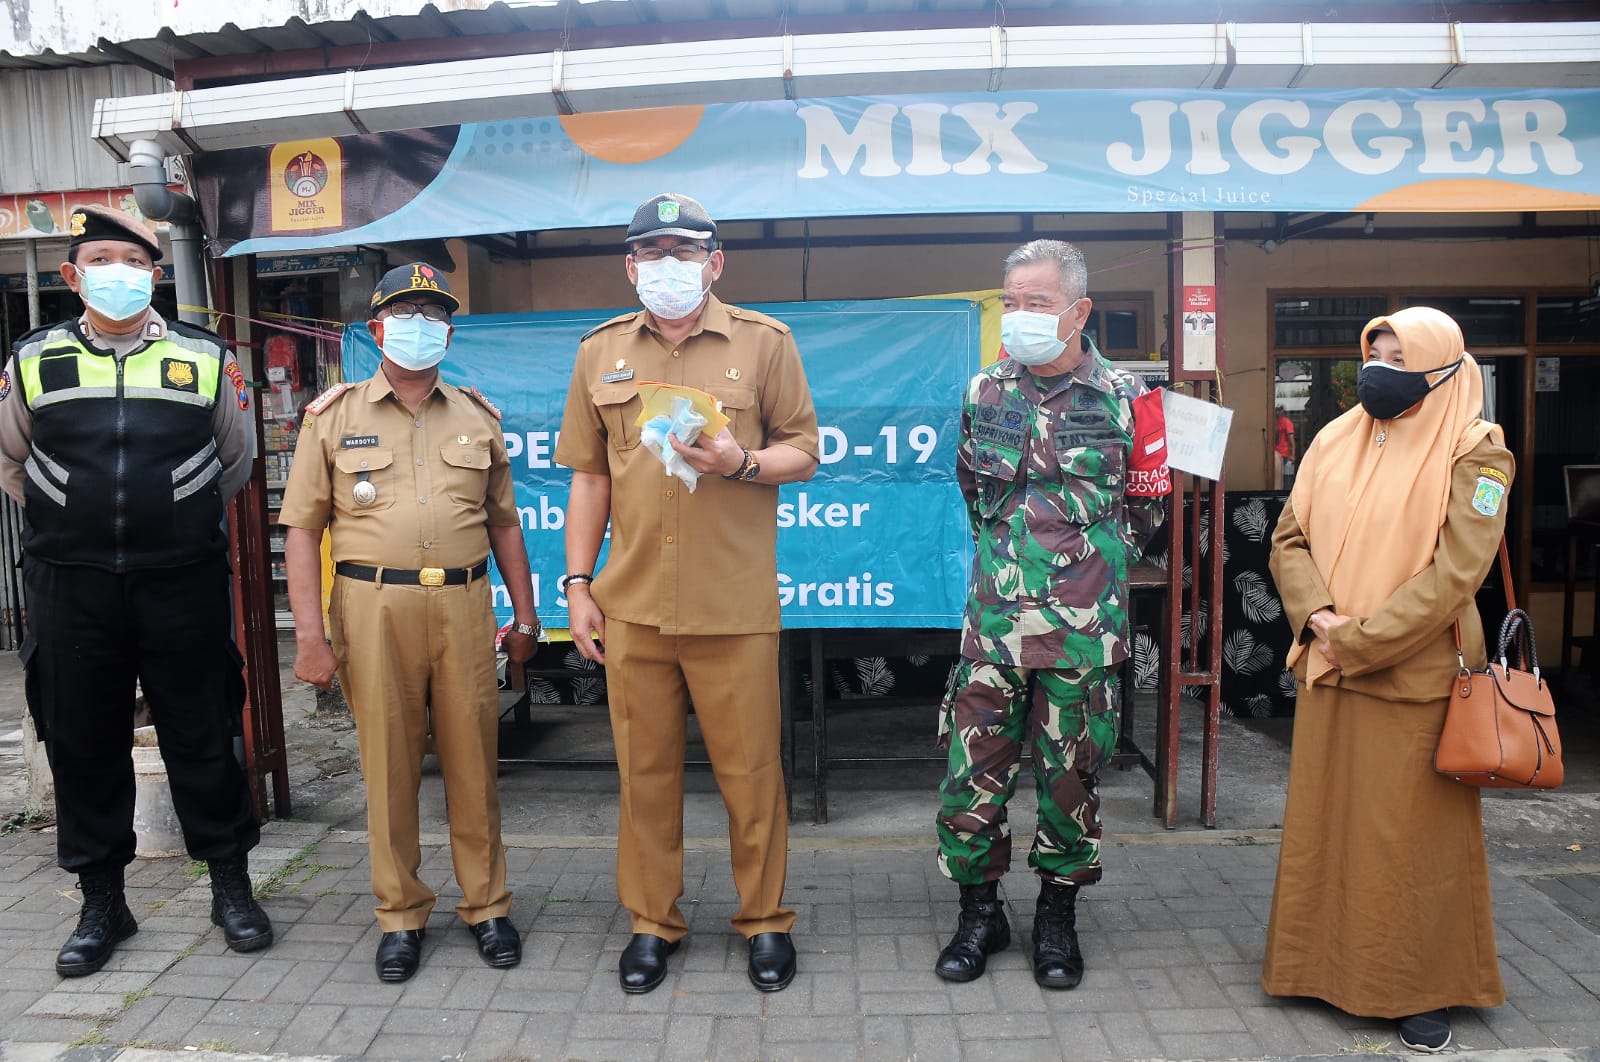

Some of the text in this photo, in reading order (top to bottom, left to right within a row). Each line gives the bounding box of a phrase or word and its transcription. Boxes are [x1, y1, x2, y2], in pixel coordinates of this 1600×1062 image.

[797, 98, 1583, 178] MIX JIGGER
[1127, 186, 1271, 205] Spezial Juice
[289, 206, 325, 216] JIGGER
[297, 200, 317, 208] MIX
[410, 276, 438, 289] PAS
[345, 438, 376, 446] WARDOYO
[818, 425, 938, 464] D-19
[777, 492, 870, 528] sker
